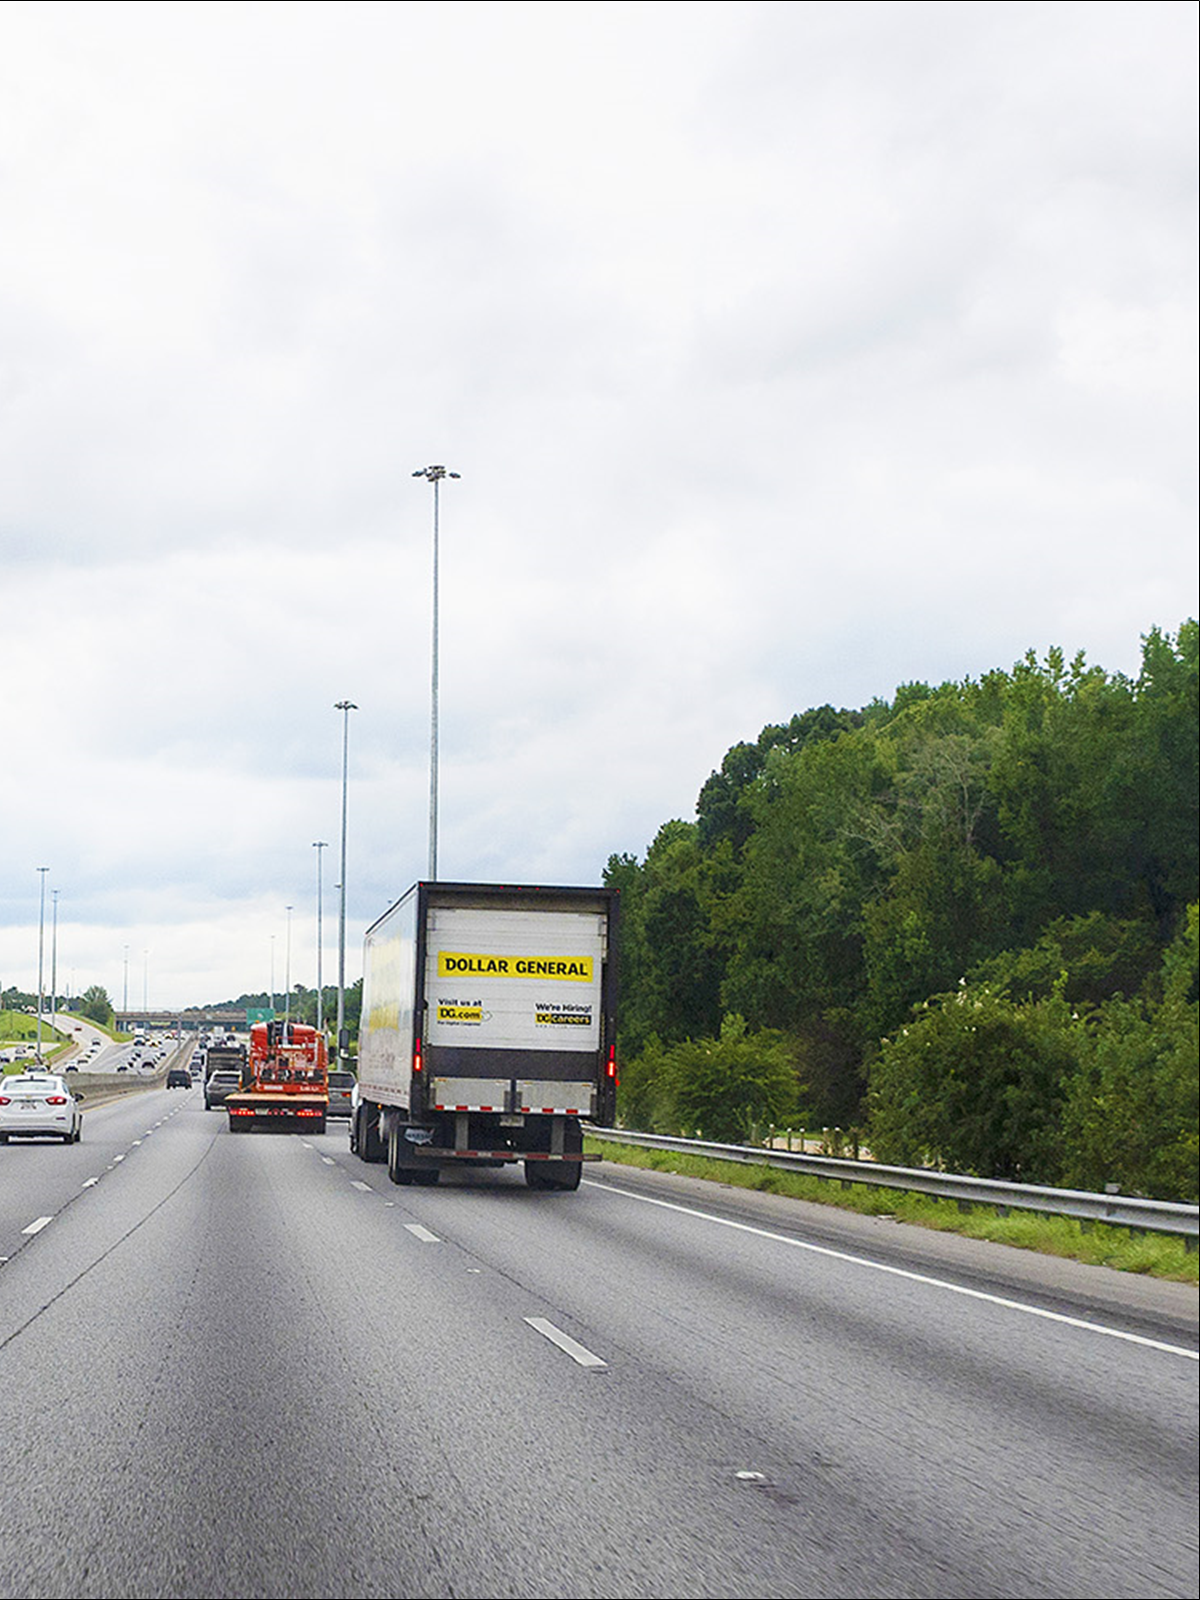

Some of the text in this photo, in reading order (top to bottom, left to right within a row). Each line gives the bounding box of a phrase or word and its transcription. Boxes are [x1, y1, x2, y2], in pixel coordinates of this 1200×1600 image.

[445, 958, 588, 976] DOLLAR GENERAL
[438, 998, 458, 1006] Visit
[472, 999, 482, 1007] at
[440, 1008, 480, 1019] DG.com
